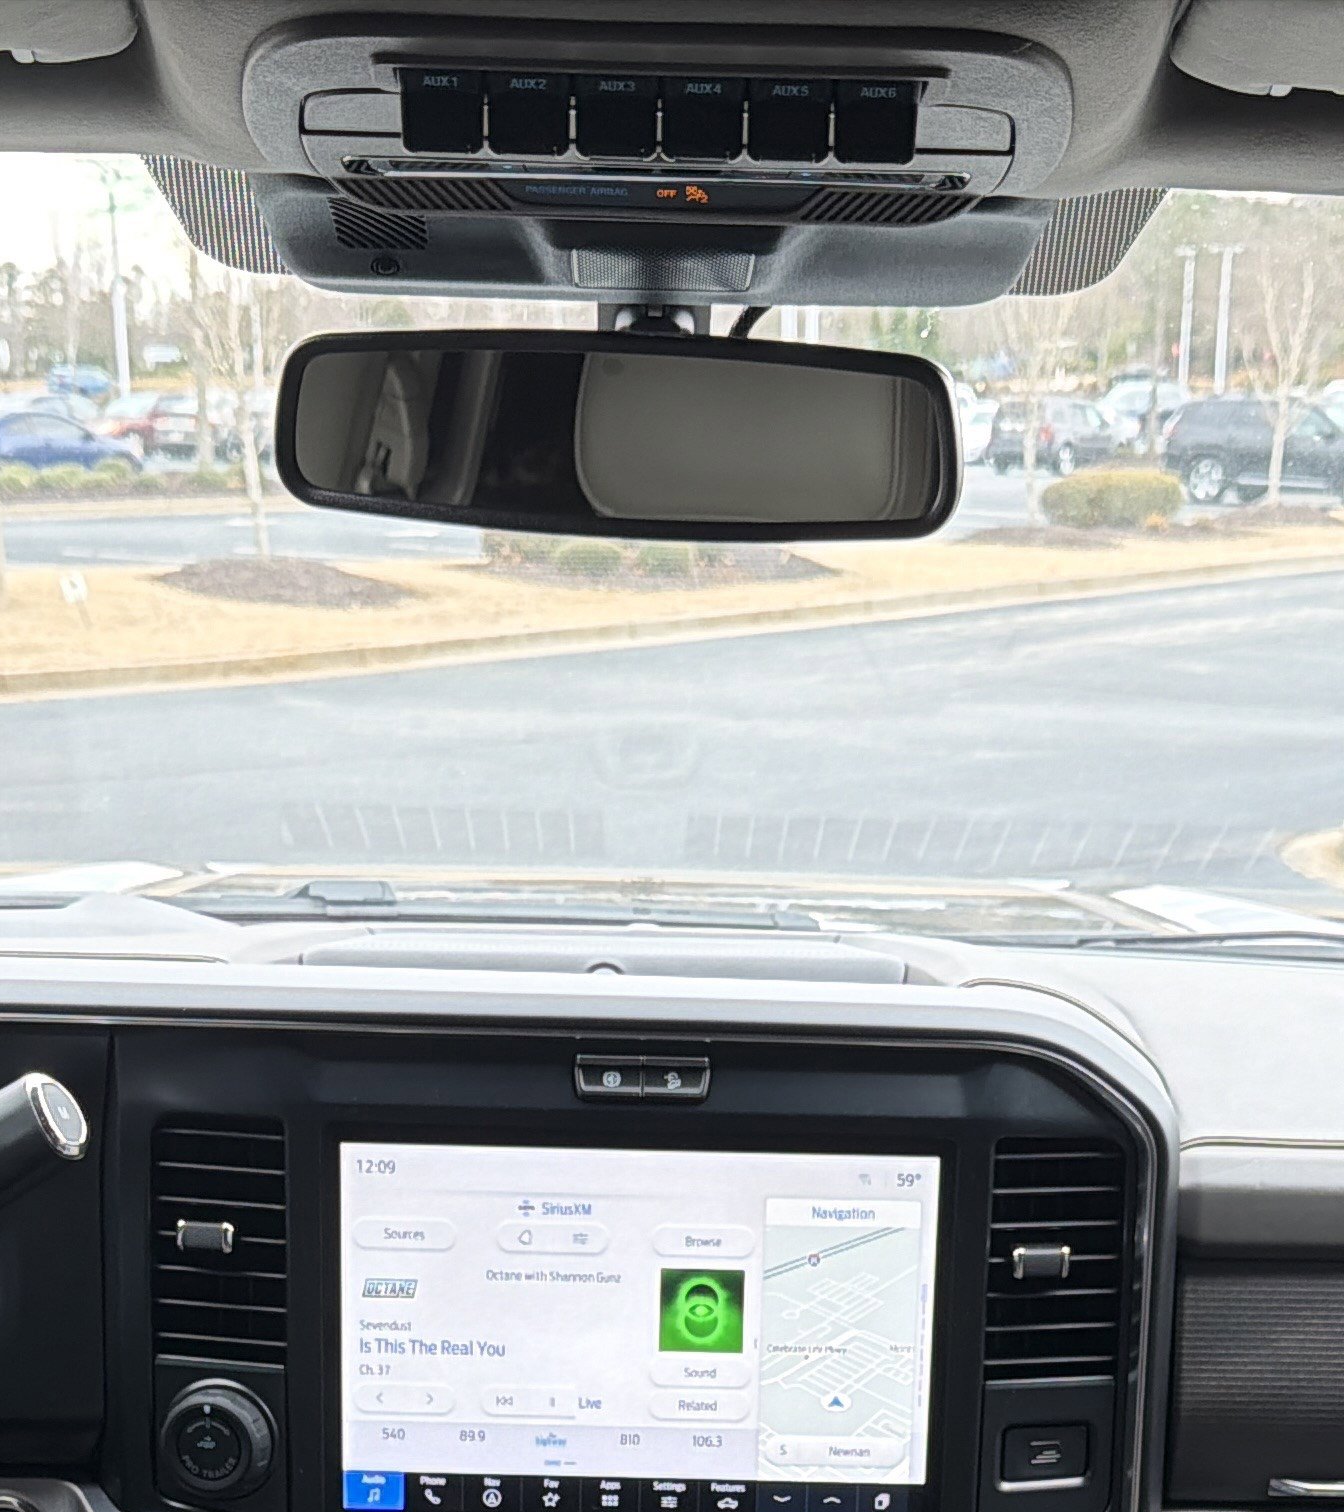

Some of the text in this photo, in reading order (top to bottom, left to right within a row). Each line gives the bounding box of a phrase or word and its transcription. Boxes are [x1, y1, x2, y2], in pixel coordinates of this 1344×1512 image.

[525, 184, 677, 198] PASSENGER AIRBAG OFF
[356, 1159, 396, 1174] 12:09
[541, 1202, 592, 1216] SiriusXM
[811, 1205, 876, 1222] Navigation
[383, 1227, 425, 1243] Sources
[684, 1235, 722, 1248] Browse
[485, 1269, 522, 1283] Octane
[524, 1270, 547, 1283] with
[549, 1270, 595, 1284] Shannon
[365, 1280, 416, 1296] OCTANE
[359, 1319, 412, 1332] Sevendust
[359, 1338, 506, 1357] Is This The Real You
[683, 1366, 717, 1380] Sound
[578, 1397, 602, 1410] Live
[678, 1399, 717, 1412] Related
[382, 1427, 406, 1441] 540
[692, 1434, 723, 1448] 106.3
[361, 1474, 386, 1485] Audio
[420, 1475, 447, 1486] Phone
[483, 1476, 501, 1488] Nav
[543, 1478, 559, 1489] Fav
[600, 1480, 621, 1491] Apps
[653, 1481, 686, 1493] Settings
[710, 1482, 745, 1493] Features
